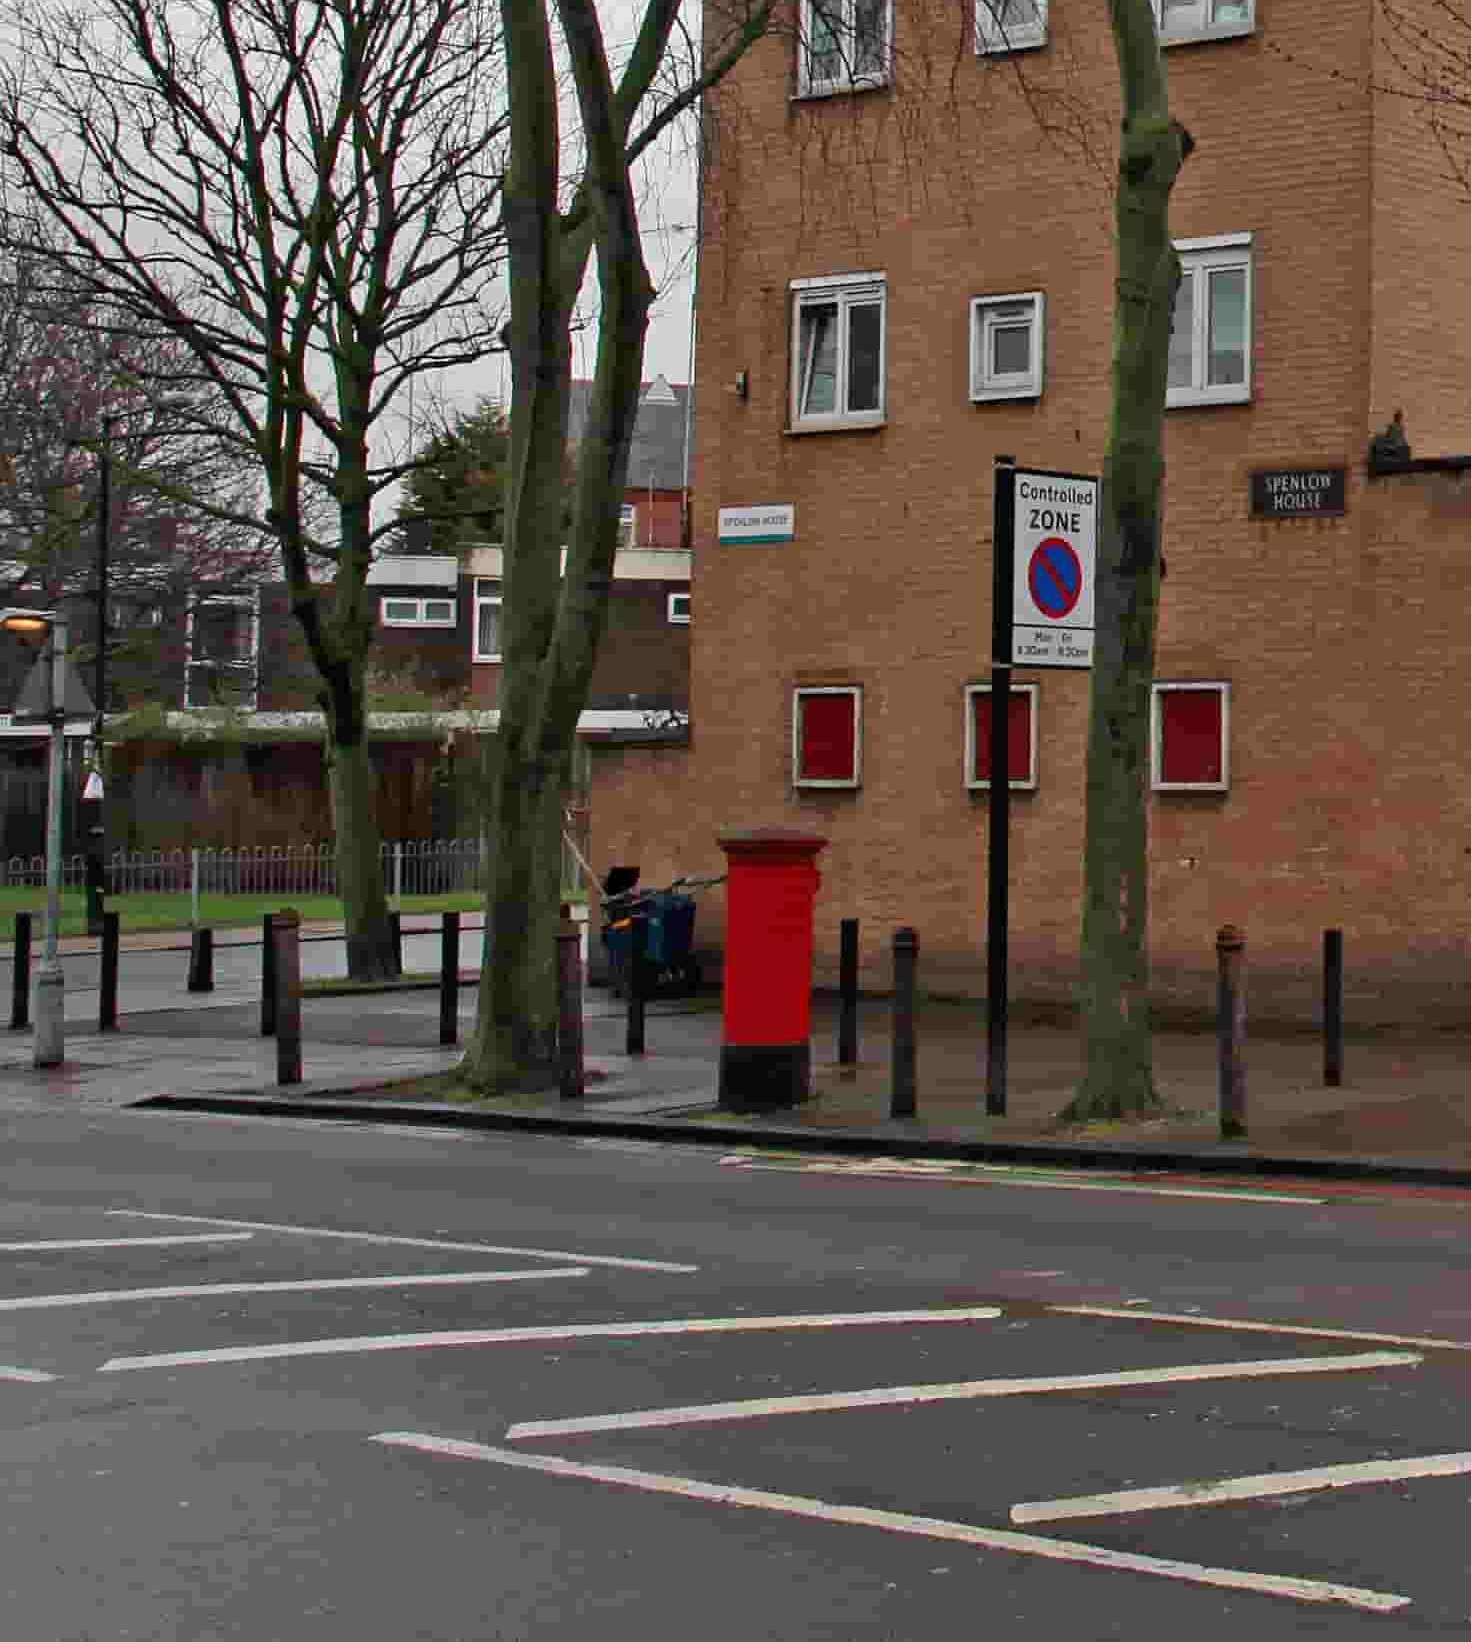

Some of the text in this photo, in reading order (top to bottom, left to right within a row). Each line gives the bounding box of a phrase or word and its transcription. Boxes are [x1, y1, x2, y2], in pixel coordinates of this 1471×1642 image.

[1020, 482, 1093, 505] Controlled
[1264, 474, 1331, 494] SPENLOW
[1273, 493, 1321, 510] HOUSE
[1029, 509, 1081, 533] ZONE
